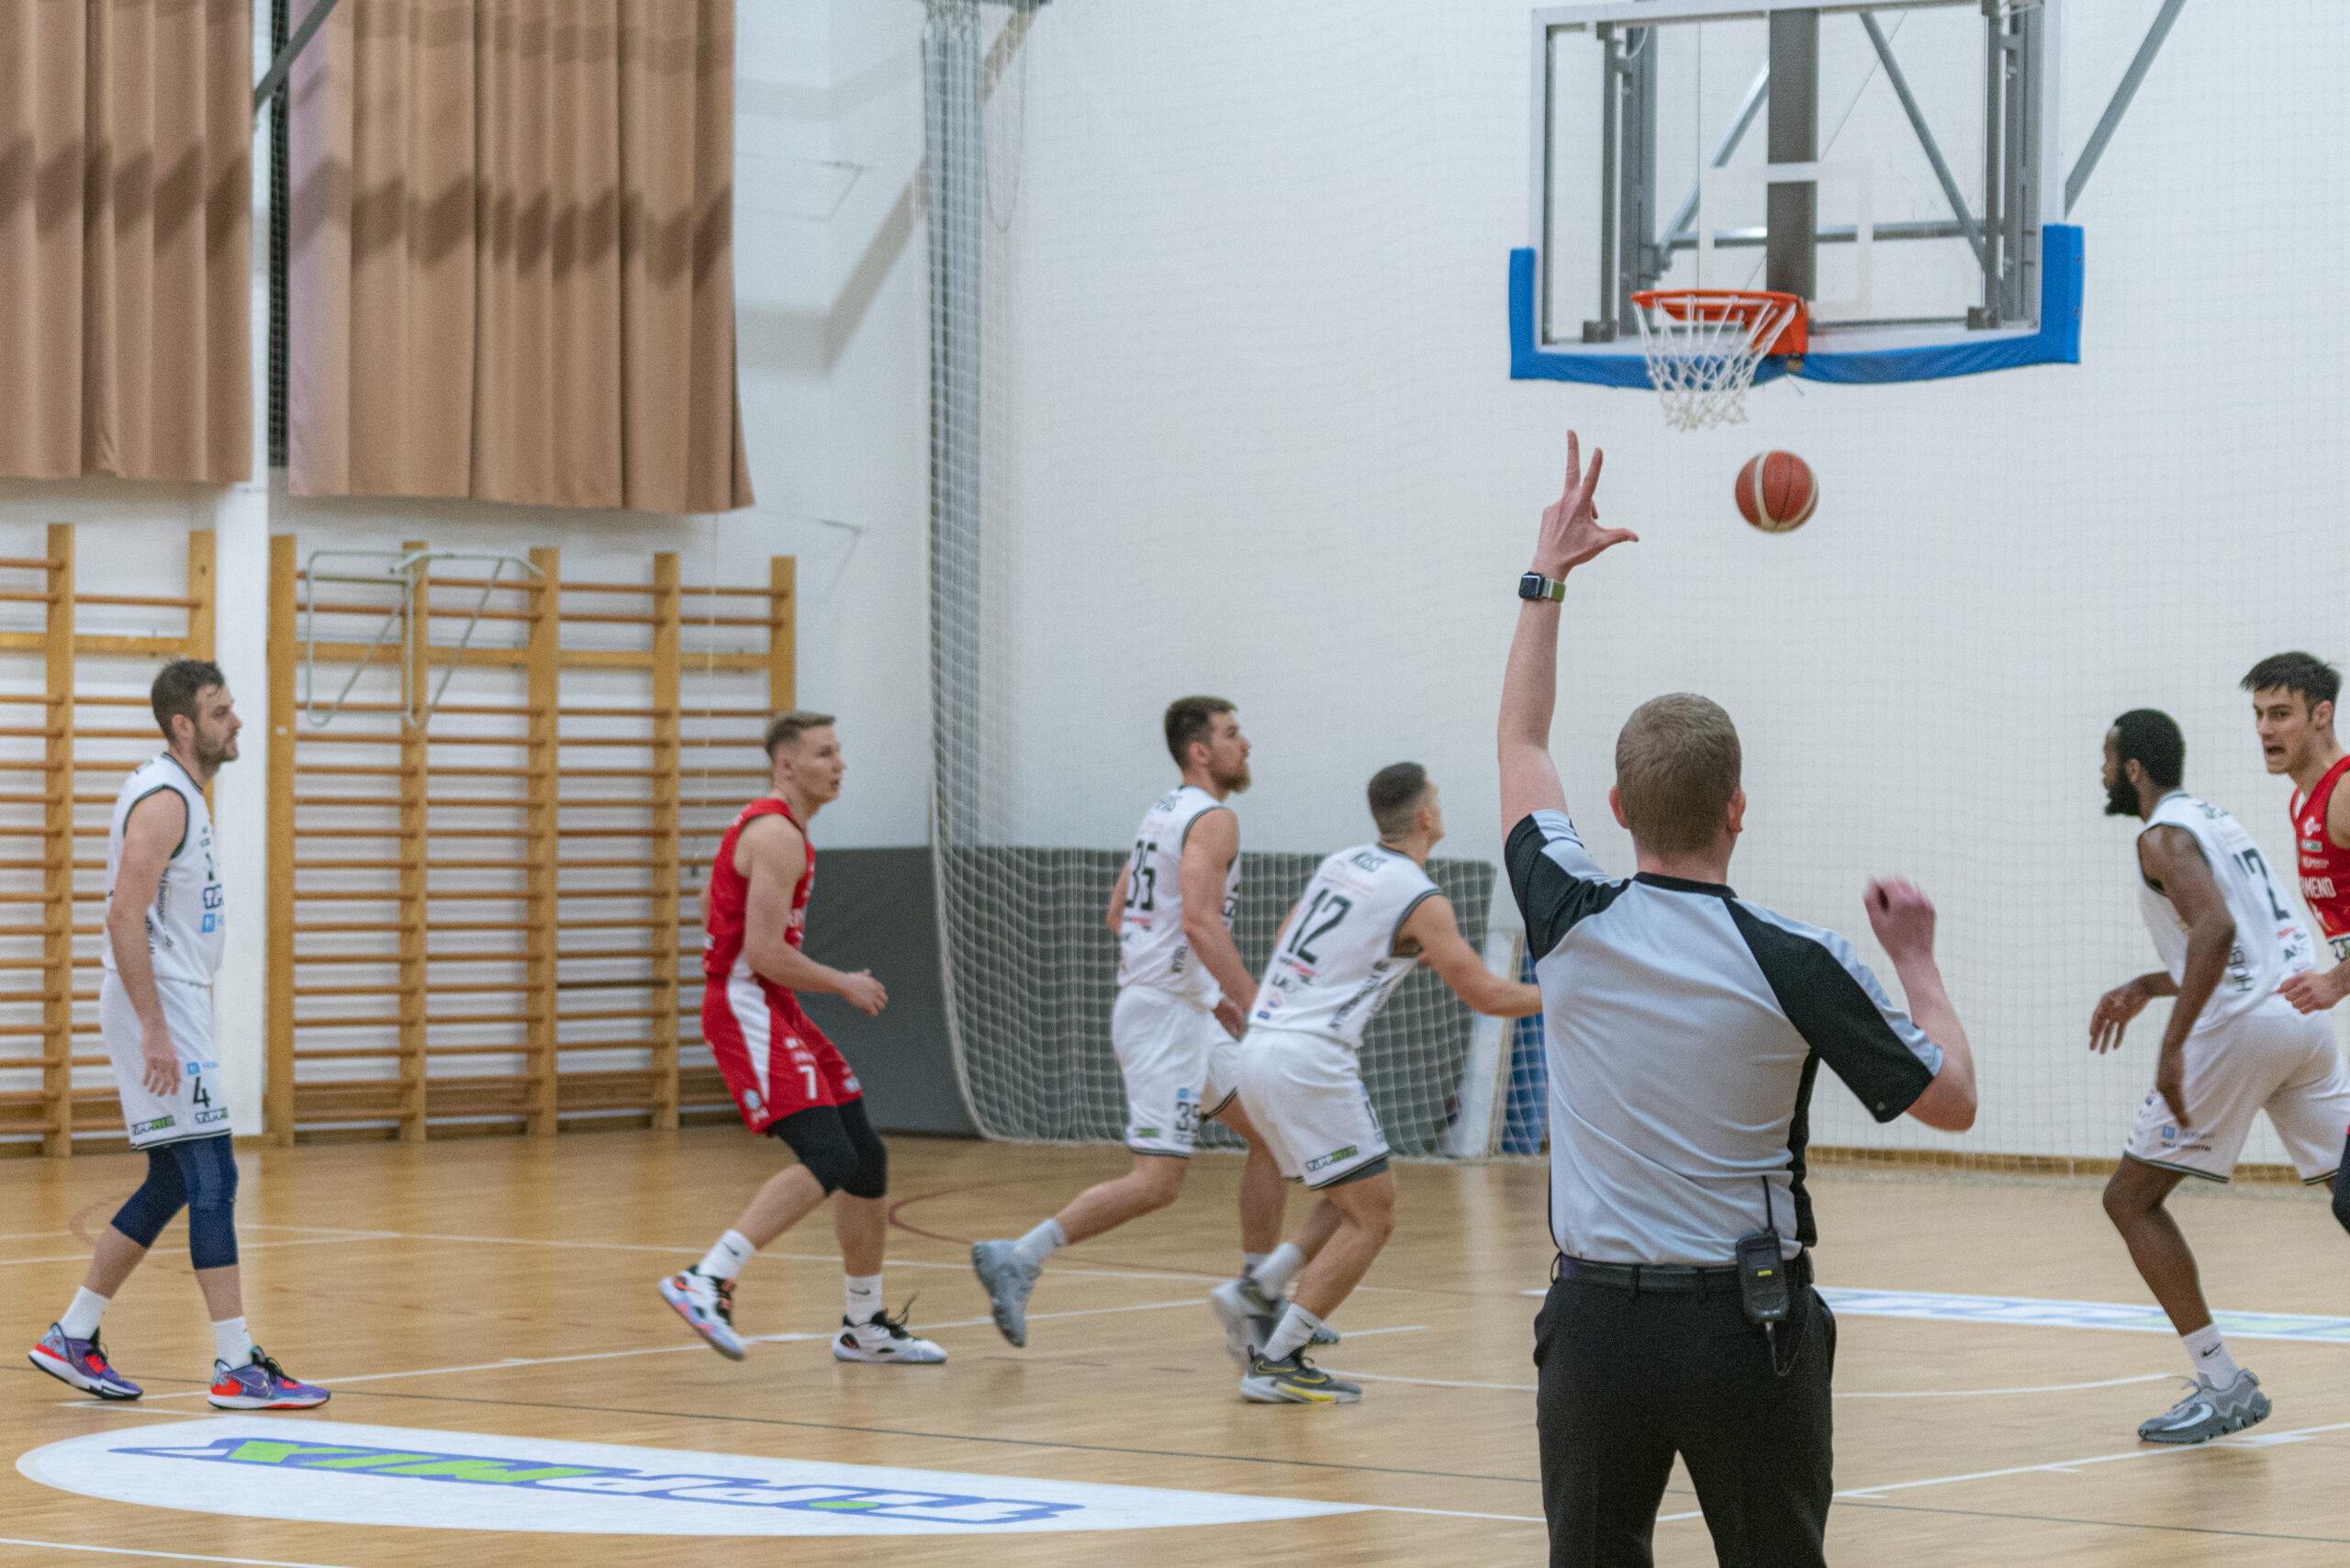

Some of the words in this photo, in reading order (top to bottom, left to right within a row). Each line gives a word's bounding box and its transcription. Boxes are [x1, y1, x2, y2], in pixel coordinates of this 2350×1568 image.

[1287, 887, 1353, 964] 12
[192, 1076, 212, 1109] 4
[798, 1065, 818, 1100] 7
